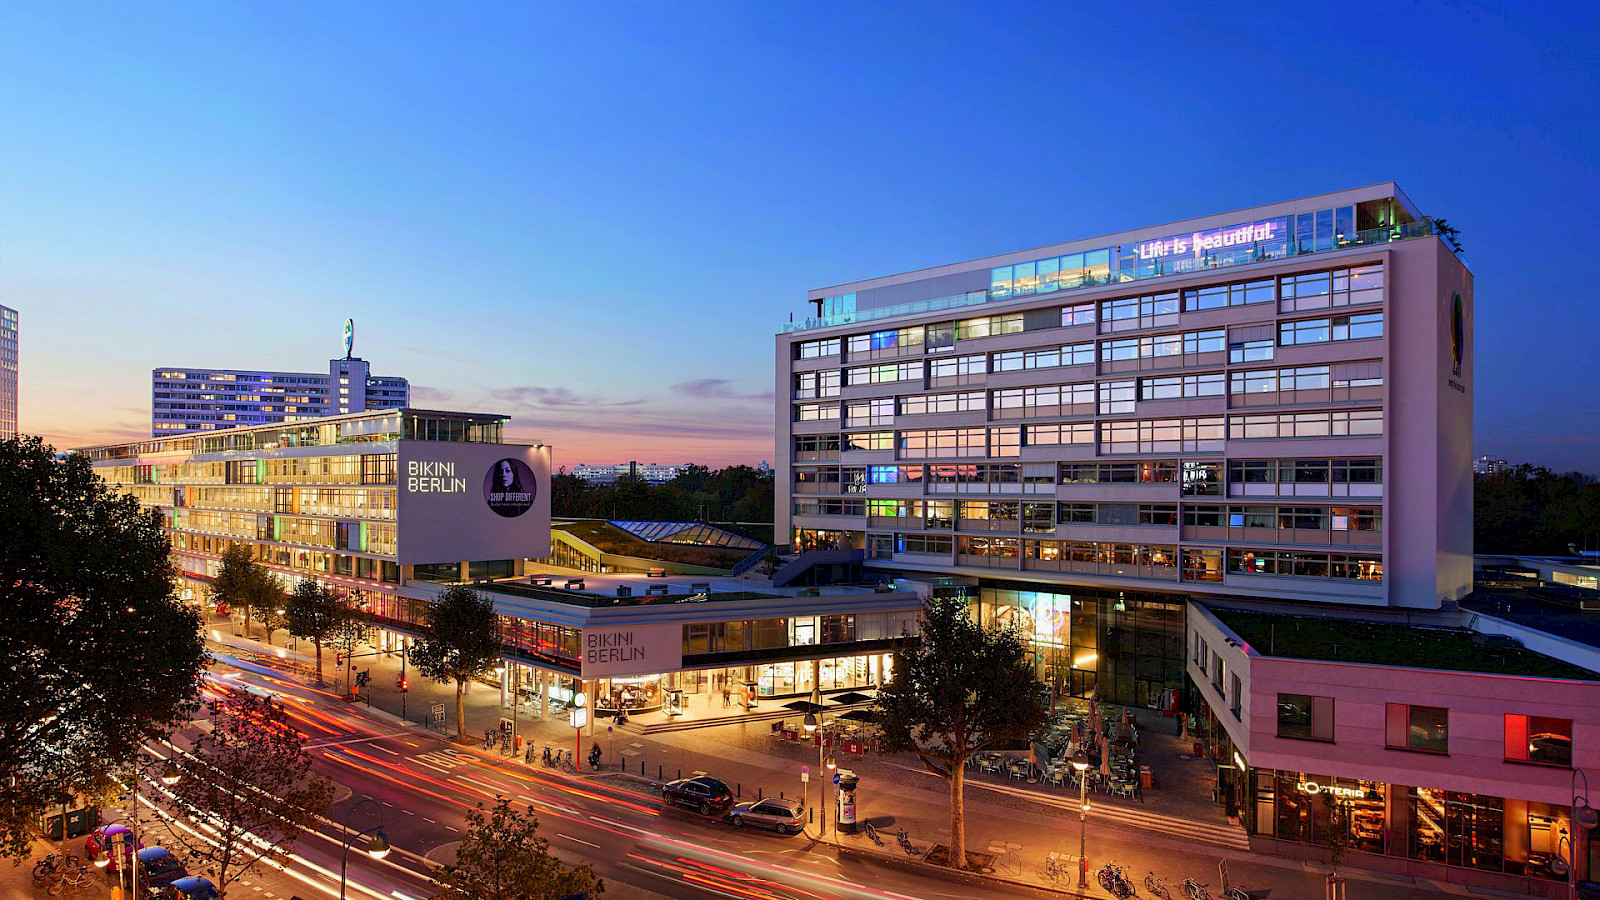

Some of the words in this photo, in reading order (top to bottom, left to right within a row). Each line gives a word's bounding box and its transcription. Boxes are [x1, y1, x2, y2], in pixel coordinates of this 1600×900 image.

[1140, 239, 1169, 259] Life
[1173, 237, 1187, 254] is
[1193, 222, 1275, 251] beautiful.
[408, 461, 455, 477] BIKINI
[408, 477, 467, 493] BERLIN
[490, 492, 504, 502] SHOP
[505, 492, 532, 502] DIFFERENT
[587, 632, 633, 648] BIKINI
[587, 646, 645, 664] BERLIN
